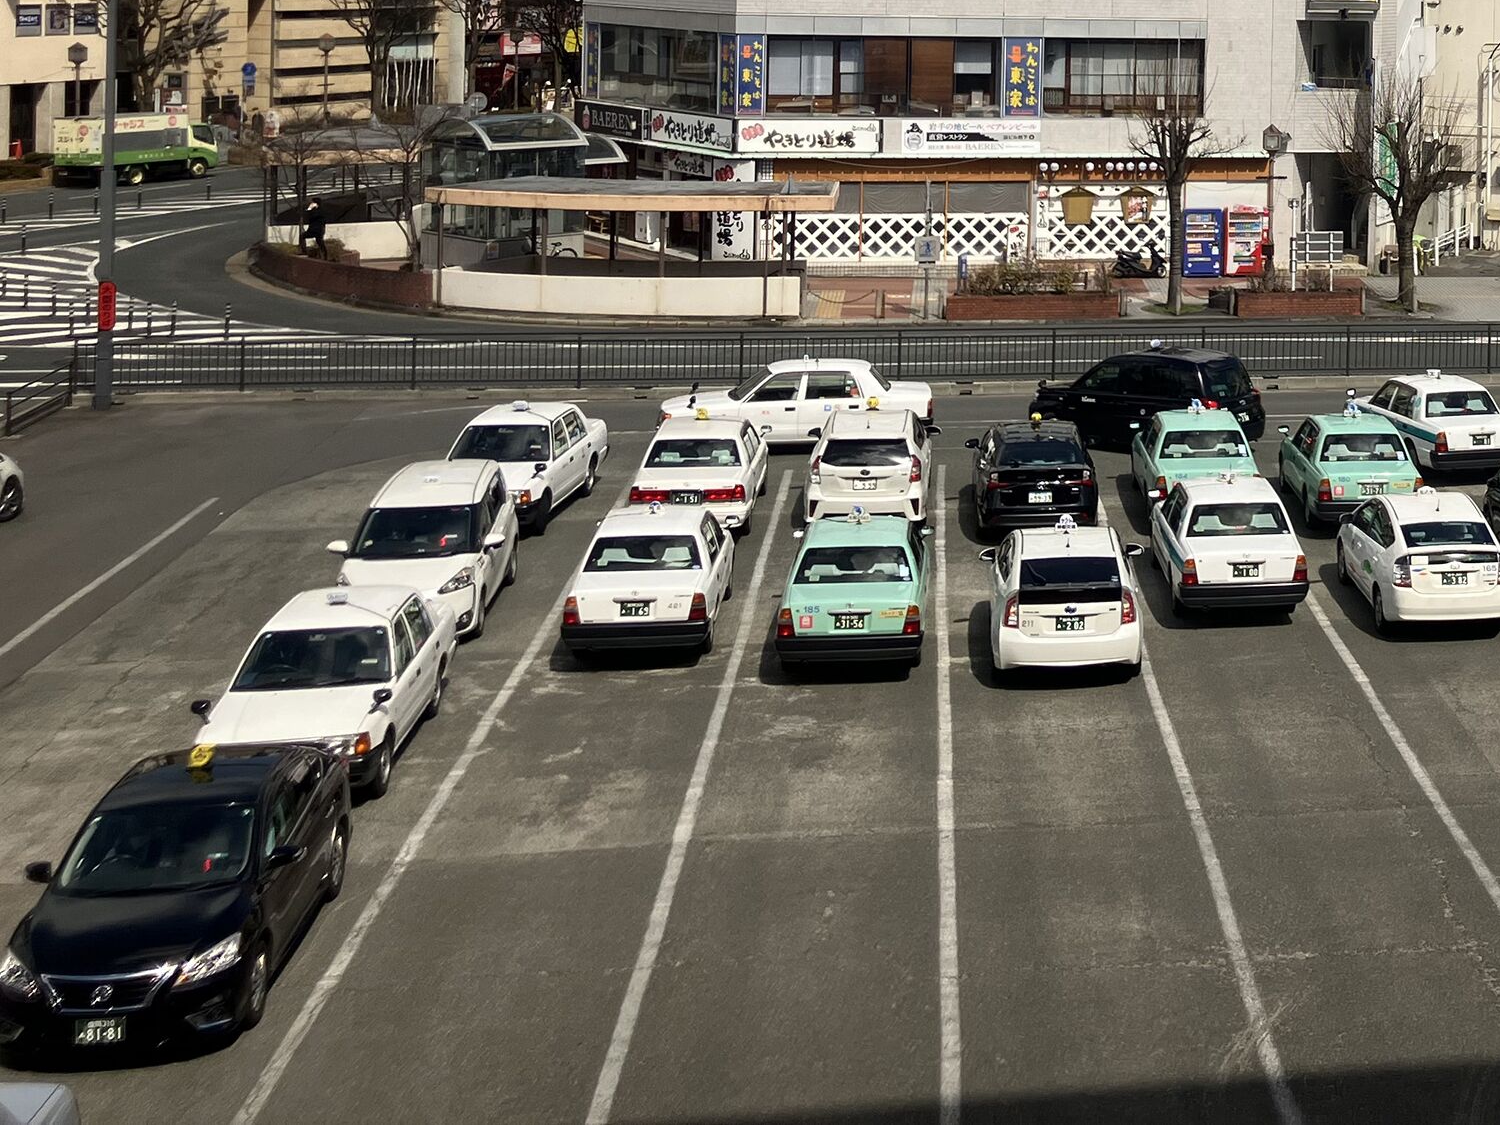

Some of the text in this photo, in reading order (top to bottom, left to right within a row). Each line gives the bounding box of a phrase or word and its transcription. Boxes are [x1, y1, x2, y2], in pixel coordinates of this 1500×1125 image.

[1026, 41, 1039, 106] わんこそば
[1009, 66, 1023, 108] 東家
[763, 129, 857, 149] やきとり道場
[804, 605, 820, 614] 185
[840, 619, 864, 629] 31-56
[1066, 621, 1084, 630] 202
[86, 1026, 122, 1041] 81-81
